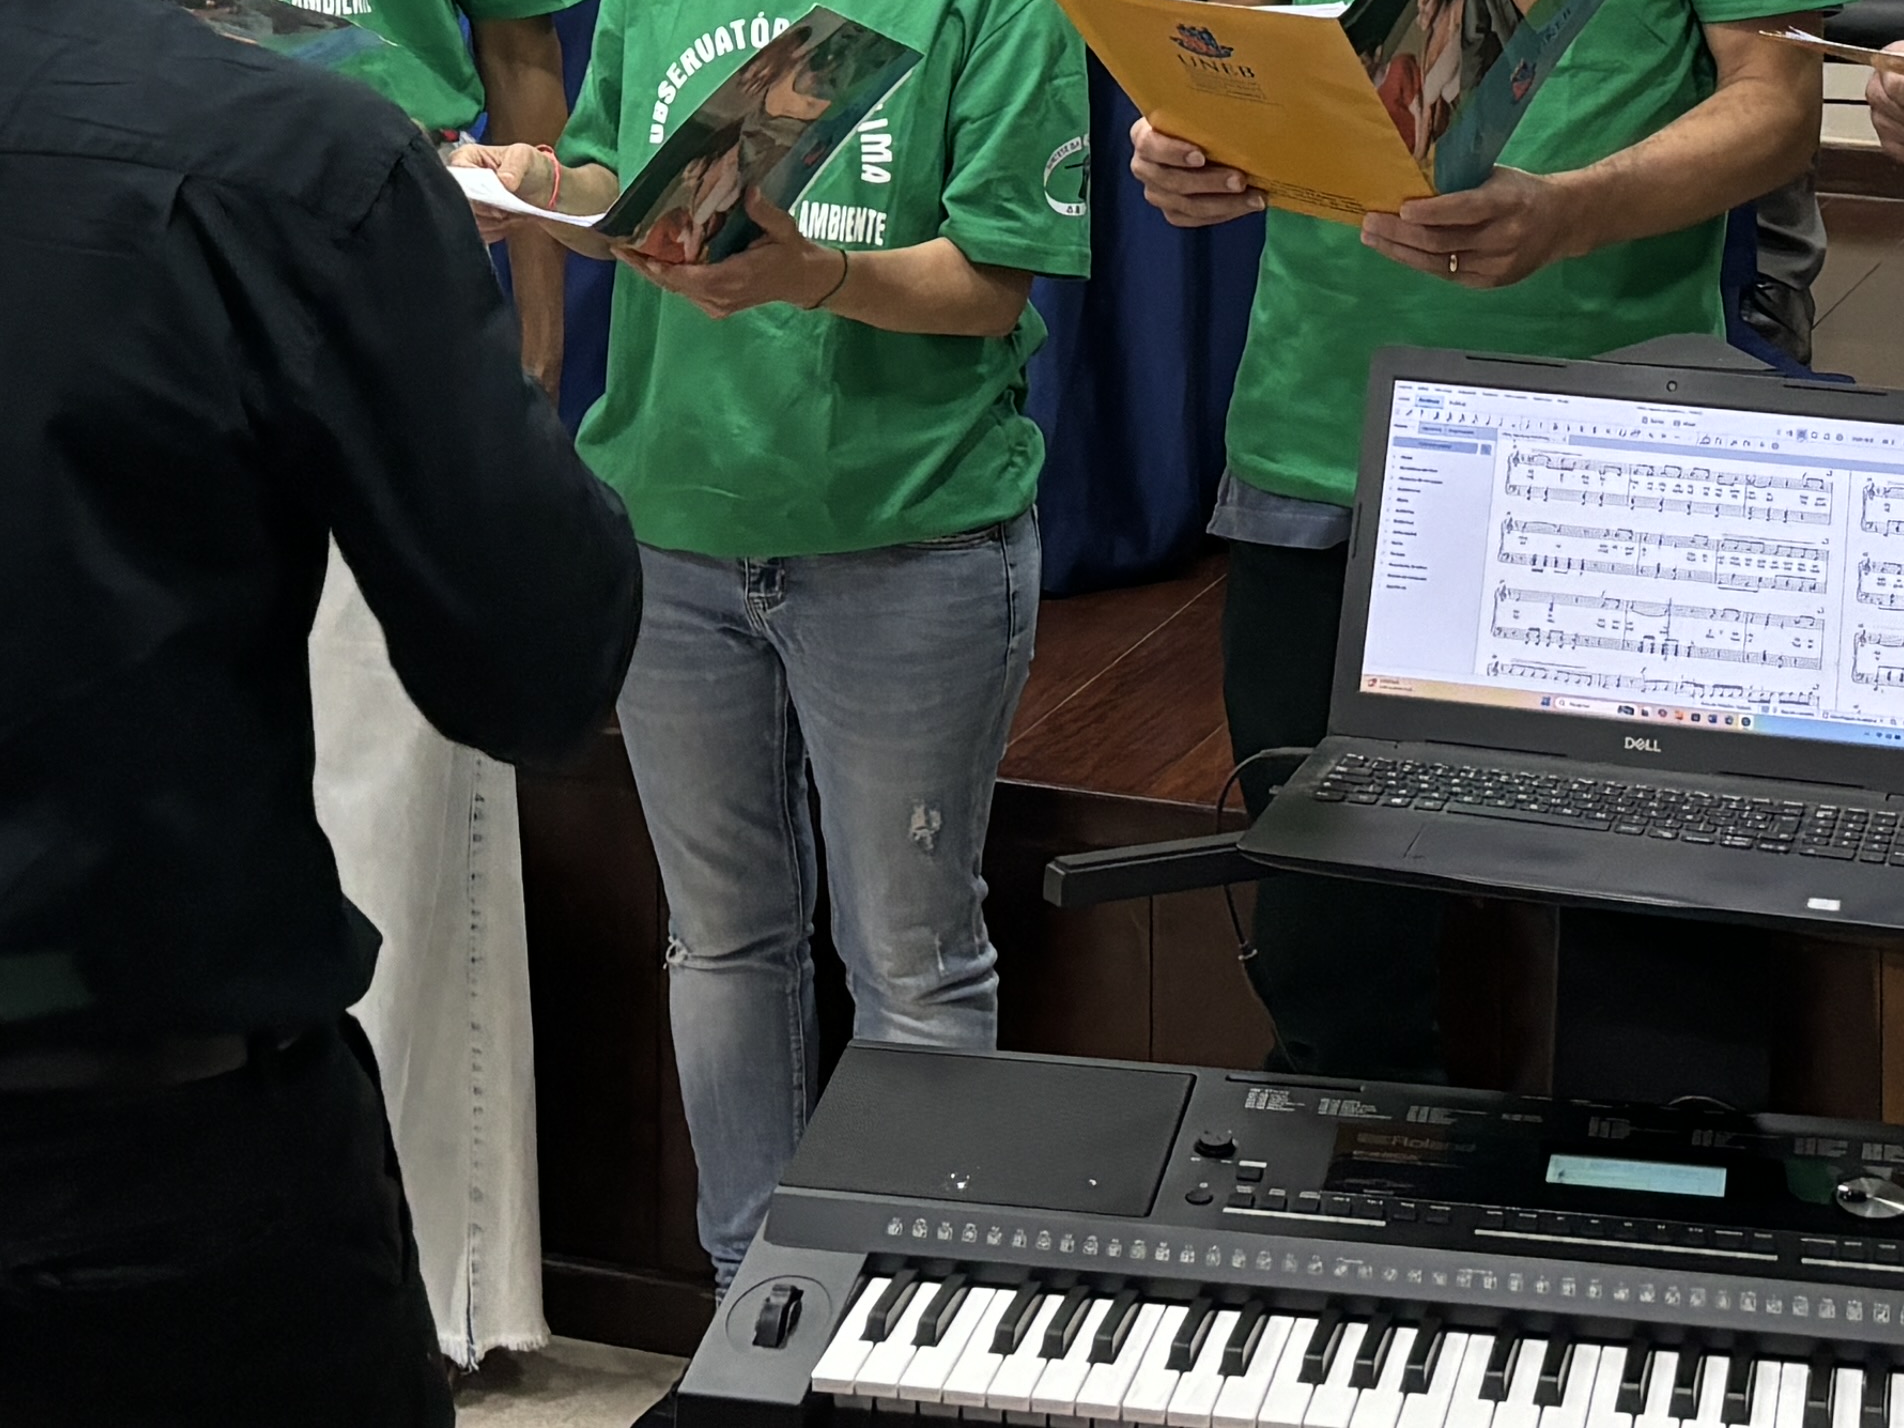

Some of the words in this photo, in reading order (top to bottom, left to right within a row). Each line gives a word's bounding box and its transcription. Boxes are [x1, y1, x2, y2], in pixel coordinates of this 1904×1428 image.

[858, 101, 893, 183] IMA
[799, 200, 887, 246] AMBIENTE
[1624, 736, 1661, 753] DELL
